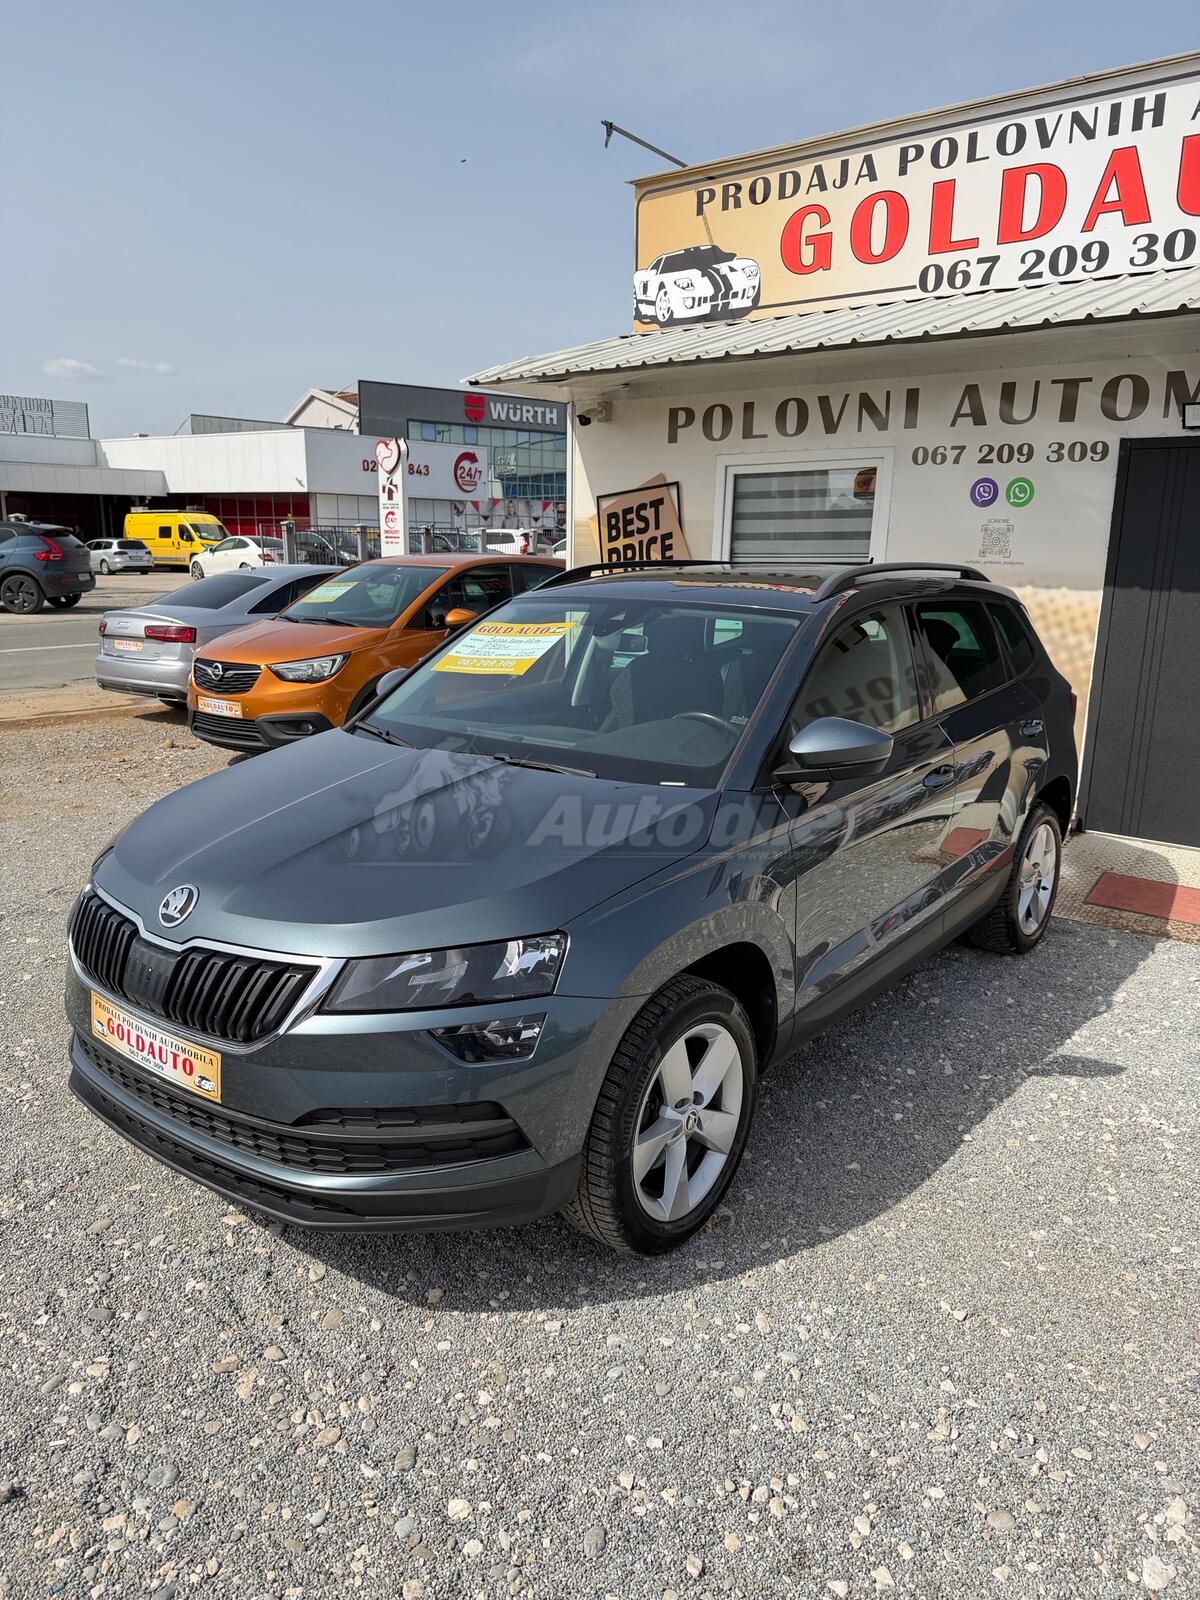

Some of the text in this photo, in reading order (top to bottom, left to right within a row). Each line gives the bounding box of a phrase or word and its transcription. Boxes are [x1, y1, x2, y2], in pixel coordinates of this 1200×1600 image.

[695, 92, 1167, 216] PRODAJA POLOVNIH
[918, 255, 1001, 294] 067
[1017, 239, 1110, 281] 209
[490, 401, 558, 426] WÜRTH
[667, 387, 920, 444] POLOVNI
[362, 459, 430, 476] 02 843
[459, 466, 482, 480] 24/7
[911, 440, 1111, 466] 067 209 309
[606, 497, 664, 544] BEST
[478, 625, 550, 635] GOLD AUTO
[94, 999, 214, 1067] PRODAJA POLOVNIH AUTOMOBILA
[107, 1017, 194, 1077] GOLDAUTO
